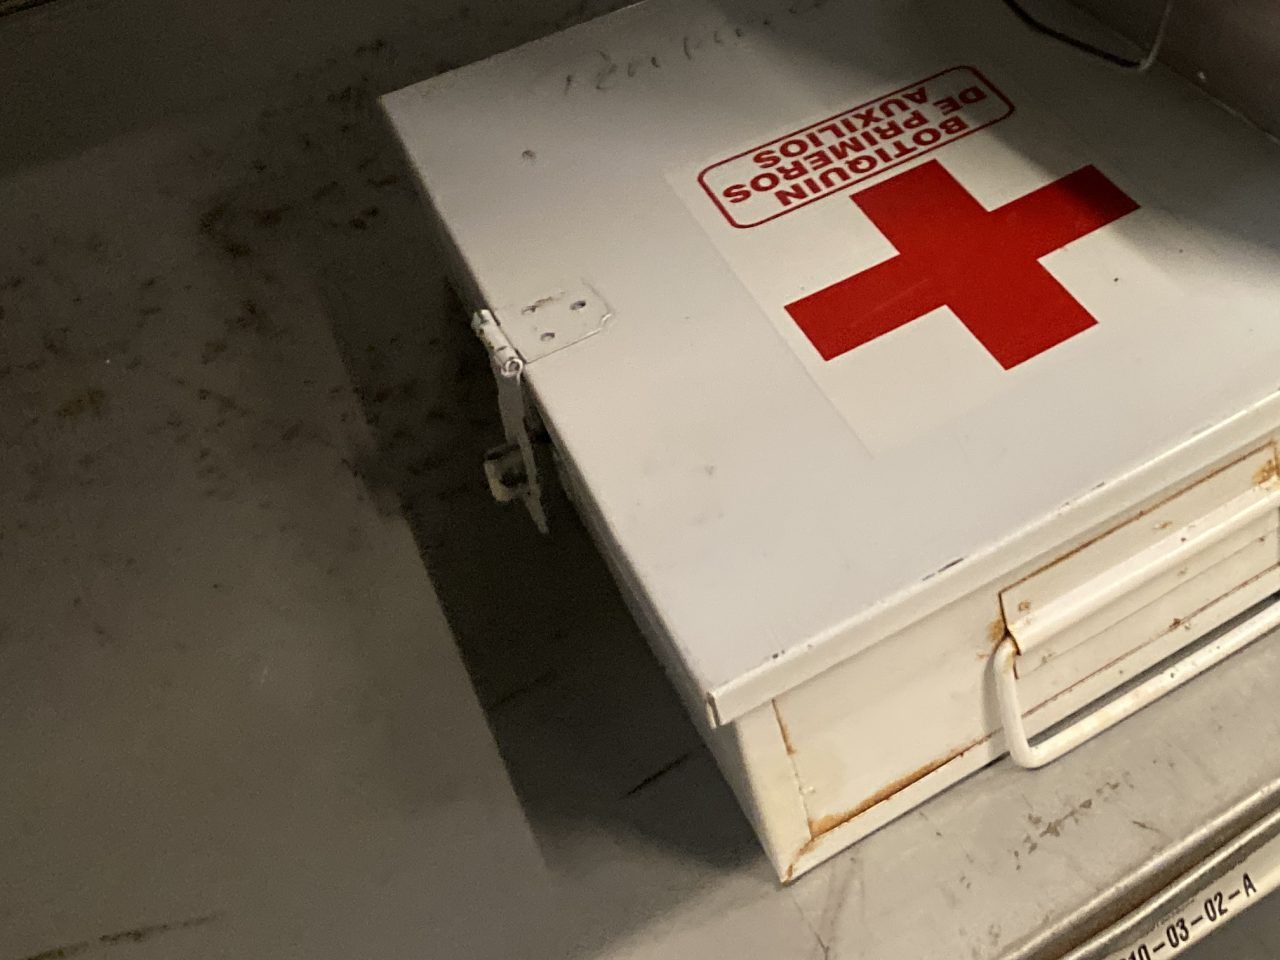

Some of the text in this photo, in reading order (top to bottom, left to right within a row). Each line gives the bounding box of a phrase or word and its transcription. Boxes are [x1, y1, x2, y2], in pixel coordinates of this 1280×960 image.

[722, 85, 988, 204] DE PRIMEROS
[752, 86, 928, 169] AUXILIOS
[774, 113, 969, 208] BOTIQUIN
